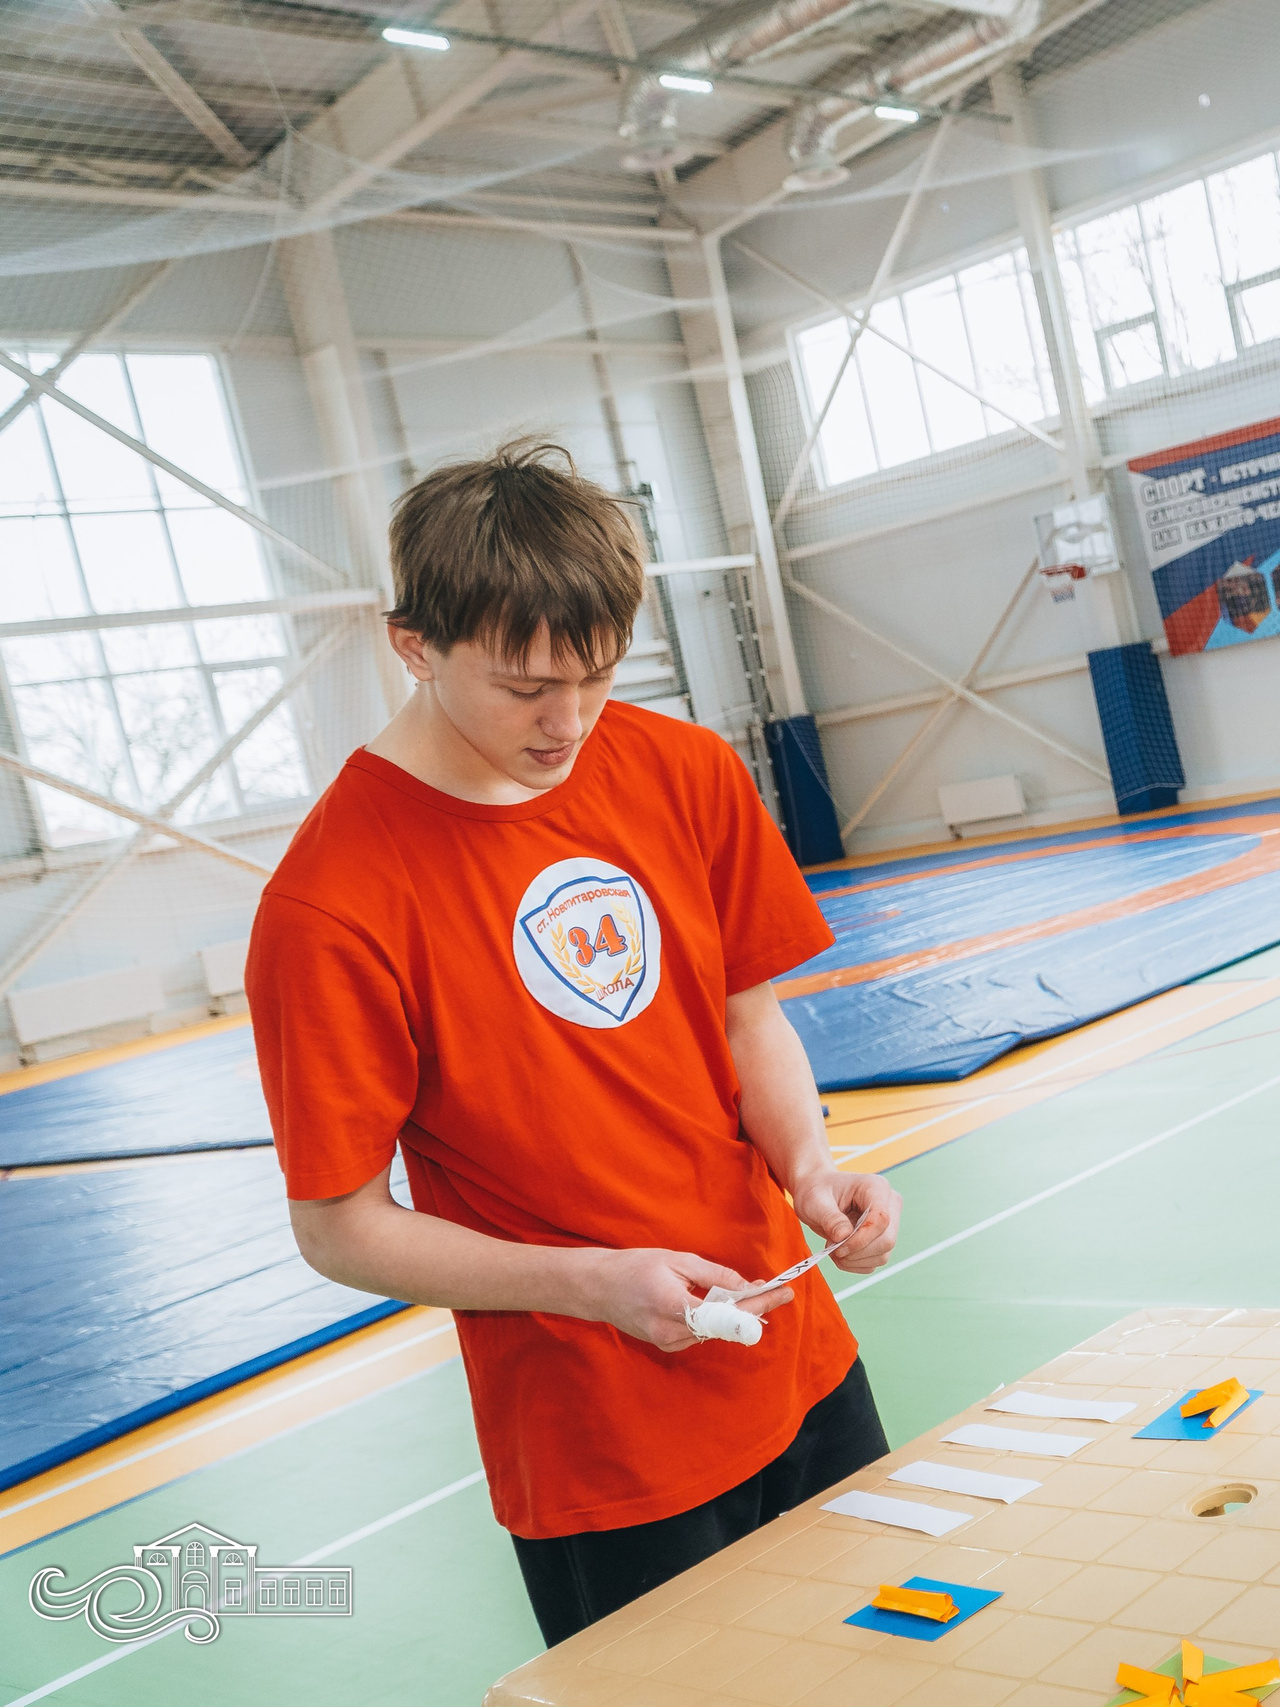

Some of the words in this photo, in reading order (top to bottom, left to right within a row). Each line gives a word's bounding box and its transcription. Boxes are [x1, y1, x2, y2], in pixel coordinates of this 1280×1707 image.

[1142, 467, 1206, 504] СПОРТ
[536, 919, 550, 934] ст.
[568, 914, 628, 967] 34
[595, 977, 635, 1001] ШКОЛА
